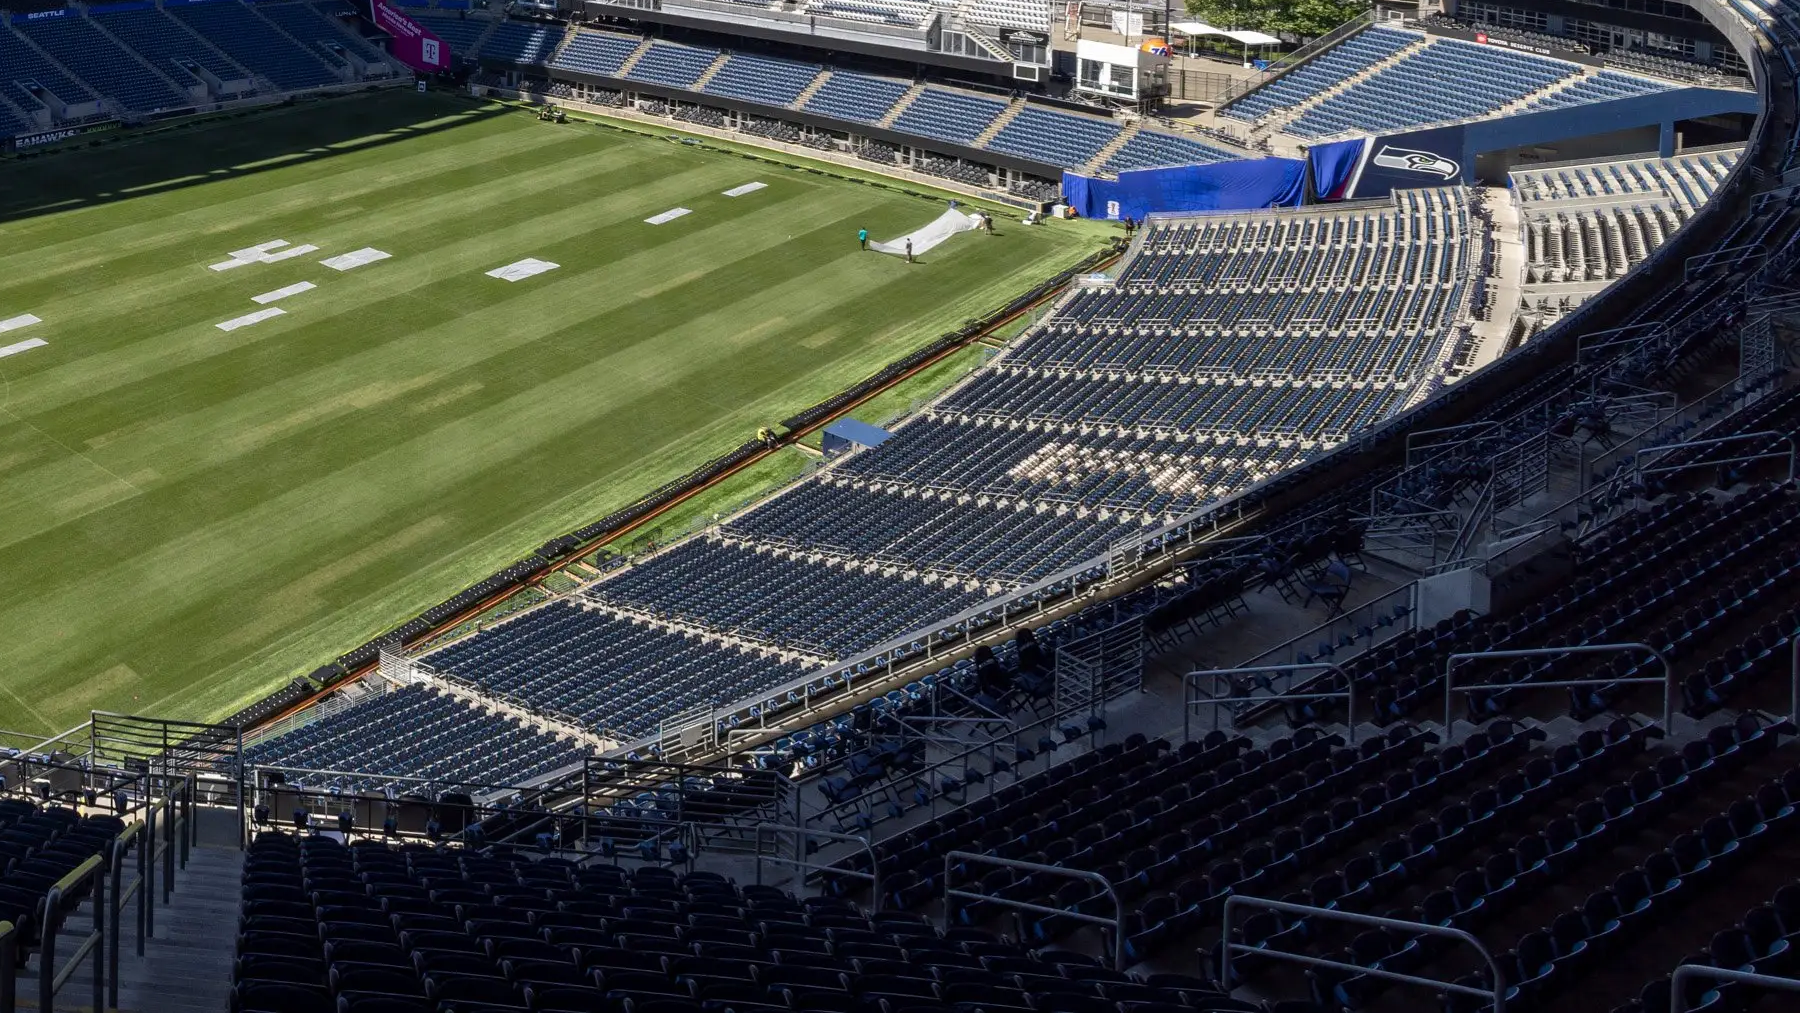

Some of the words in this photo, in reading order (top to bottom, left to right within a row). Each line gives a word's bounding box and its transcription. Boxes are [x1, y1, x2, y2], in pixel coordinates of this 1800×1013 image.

[27, 9, 65, 20] SEATTLE
[377, 2, 408, 25] America's
[407, 22, 421, 36] Best
[1487, 38, 1508, 46] TOYOTA
[1510, 42, 1534, 51] RESERVE
[426, 44, 436, 59] T
[1151, 48, 1168, 56] 76
